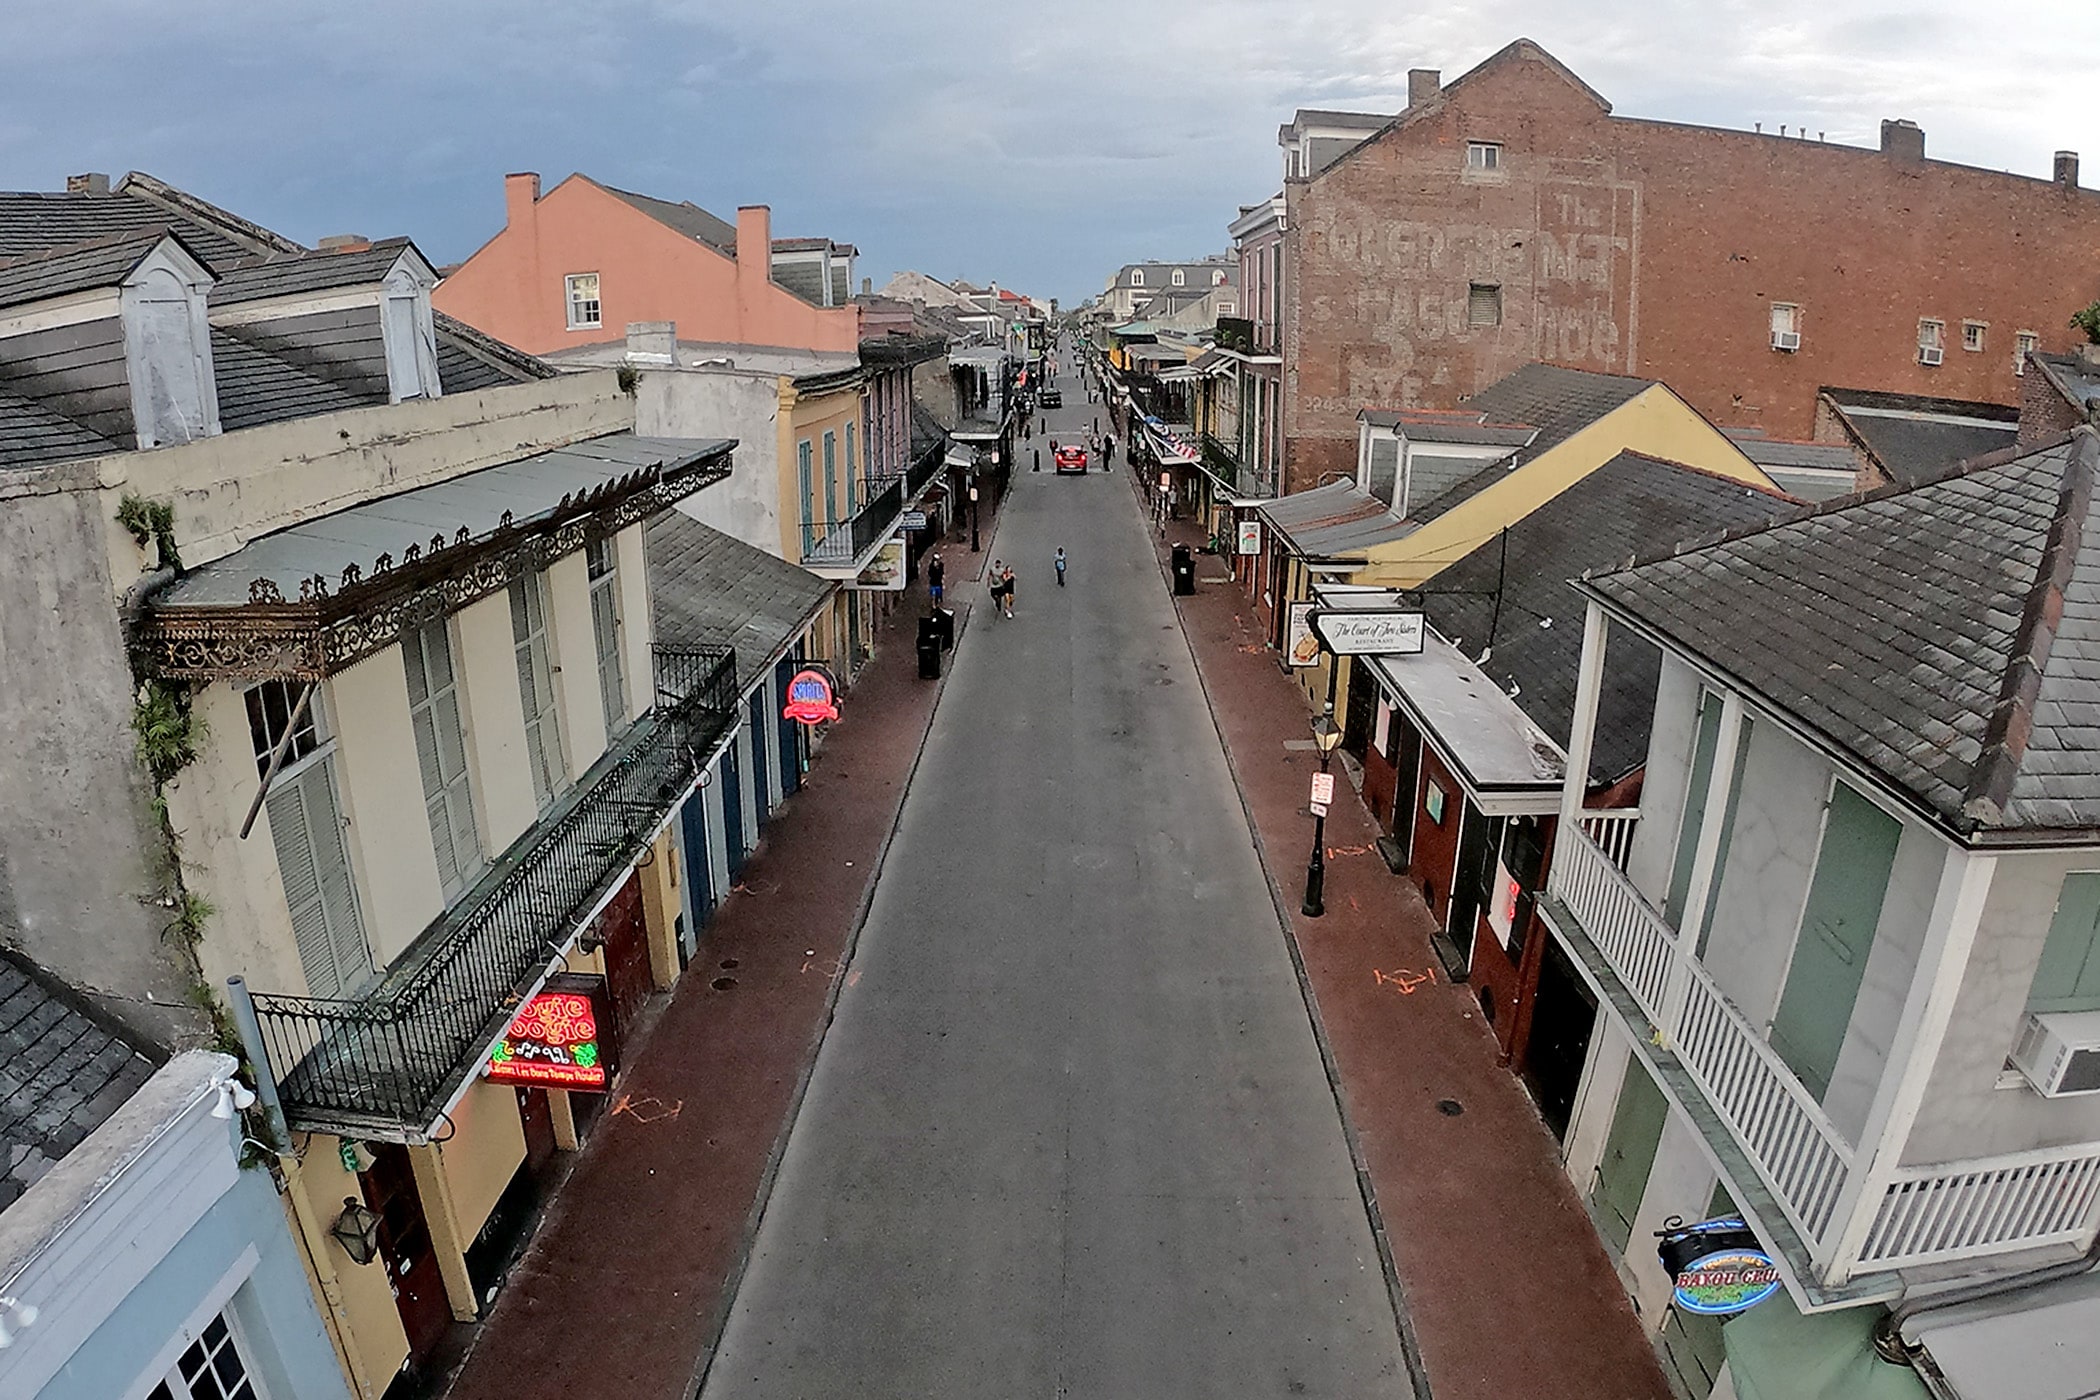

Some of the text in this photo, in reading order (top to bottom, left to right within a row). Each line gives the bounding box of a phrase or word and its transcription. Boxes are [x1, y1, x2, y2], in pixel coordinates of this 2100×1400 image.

[1335, 622, 1350, 638] The
[1350, 622, 1371, 636] Court
[1380, 621, 1395, 637] Two
[519, 996, 583, 1023] ogie
[509, 1019, 594, 1045] oogie
[1677, 1268, 1781, 1288] BAYOU CLU
